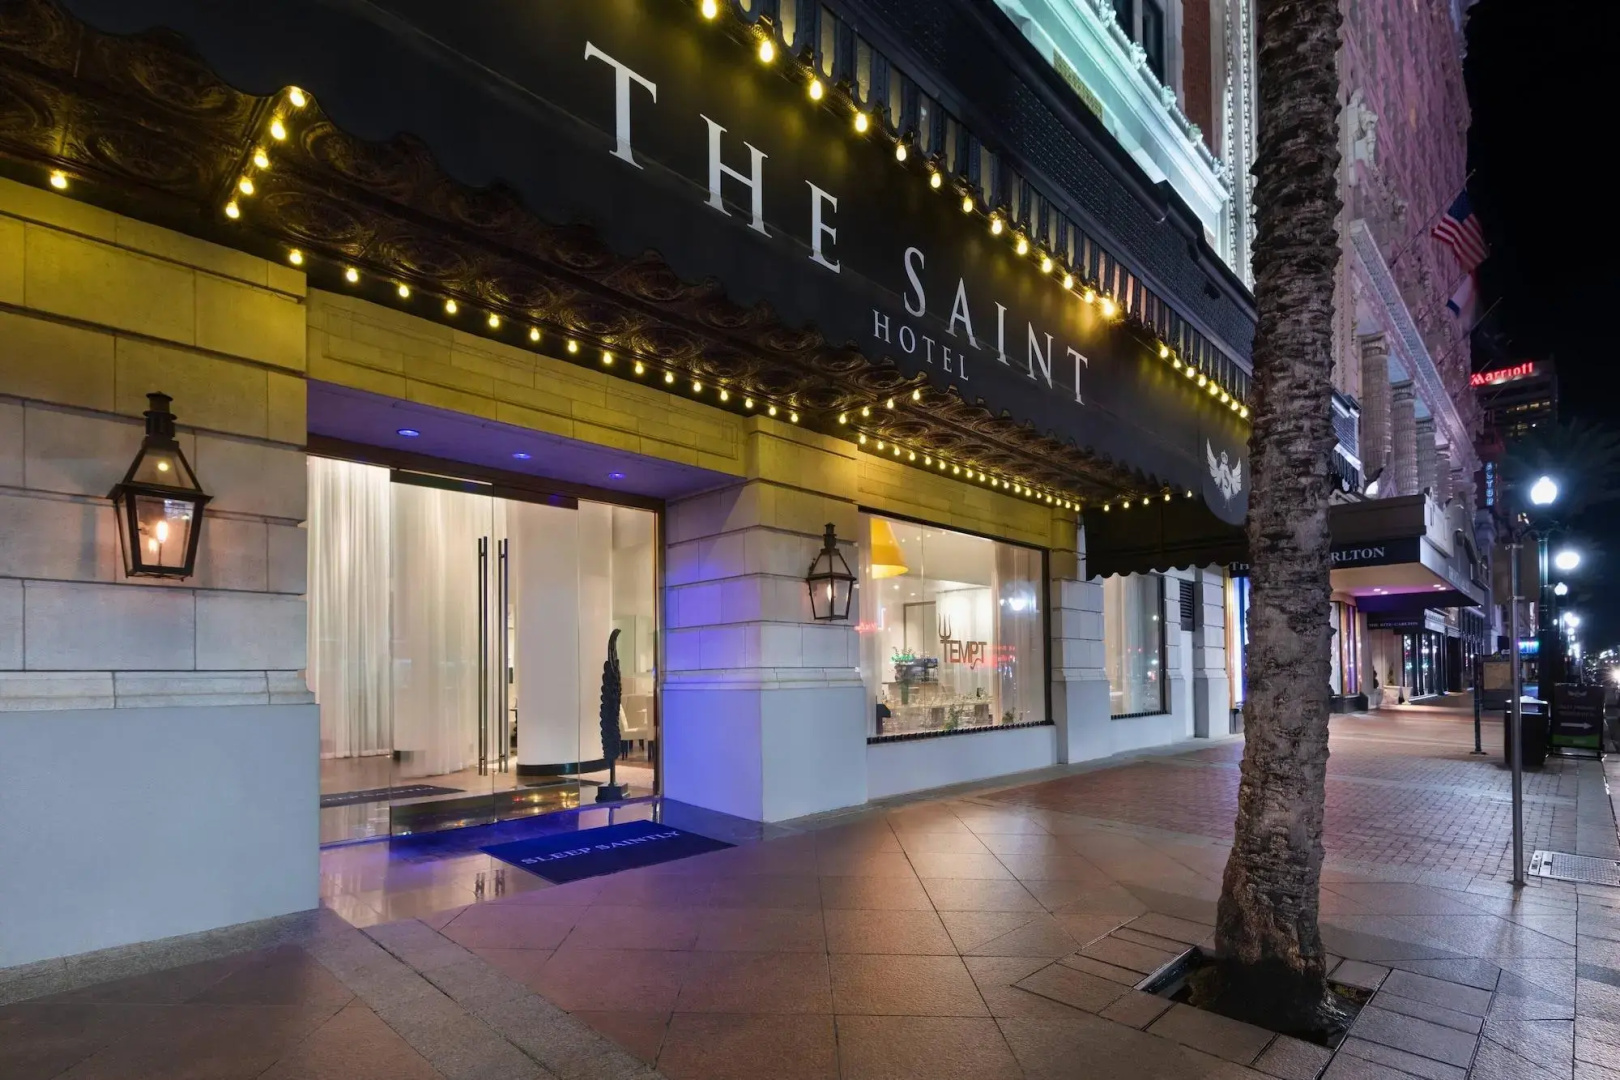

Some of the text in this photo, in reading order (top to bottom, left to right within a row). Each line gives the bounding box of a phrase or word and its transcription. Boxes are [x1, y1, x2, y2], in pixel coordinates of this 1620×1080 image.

[584, 40, 1089, 406] THE SAINT
[872, 308, 969, 382] HOTEL
[1470, 362, 1533, 386] Marriott
[1331, 547, 1386, 562] RLTON
[938, 638, 988, 669] TEMPT
[521, 830, 681, 865] SLEEP SAINTLY
